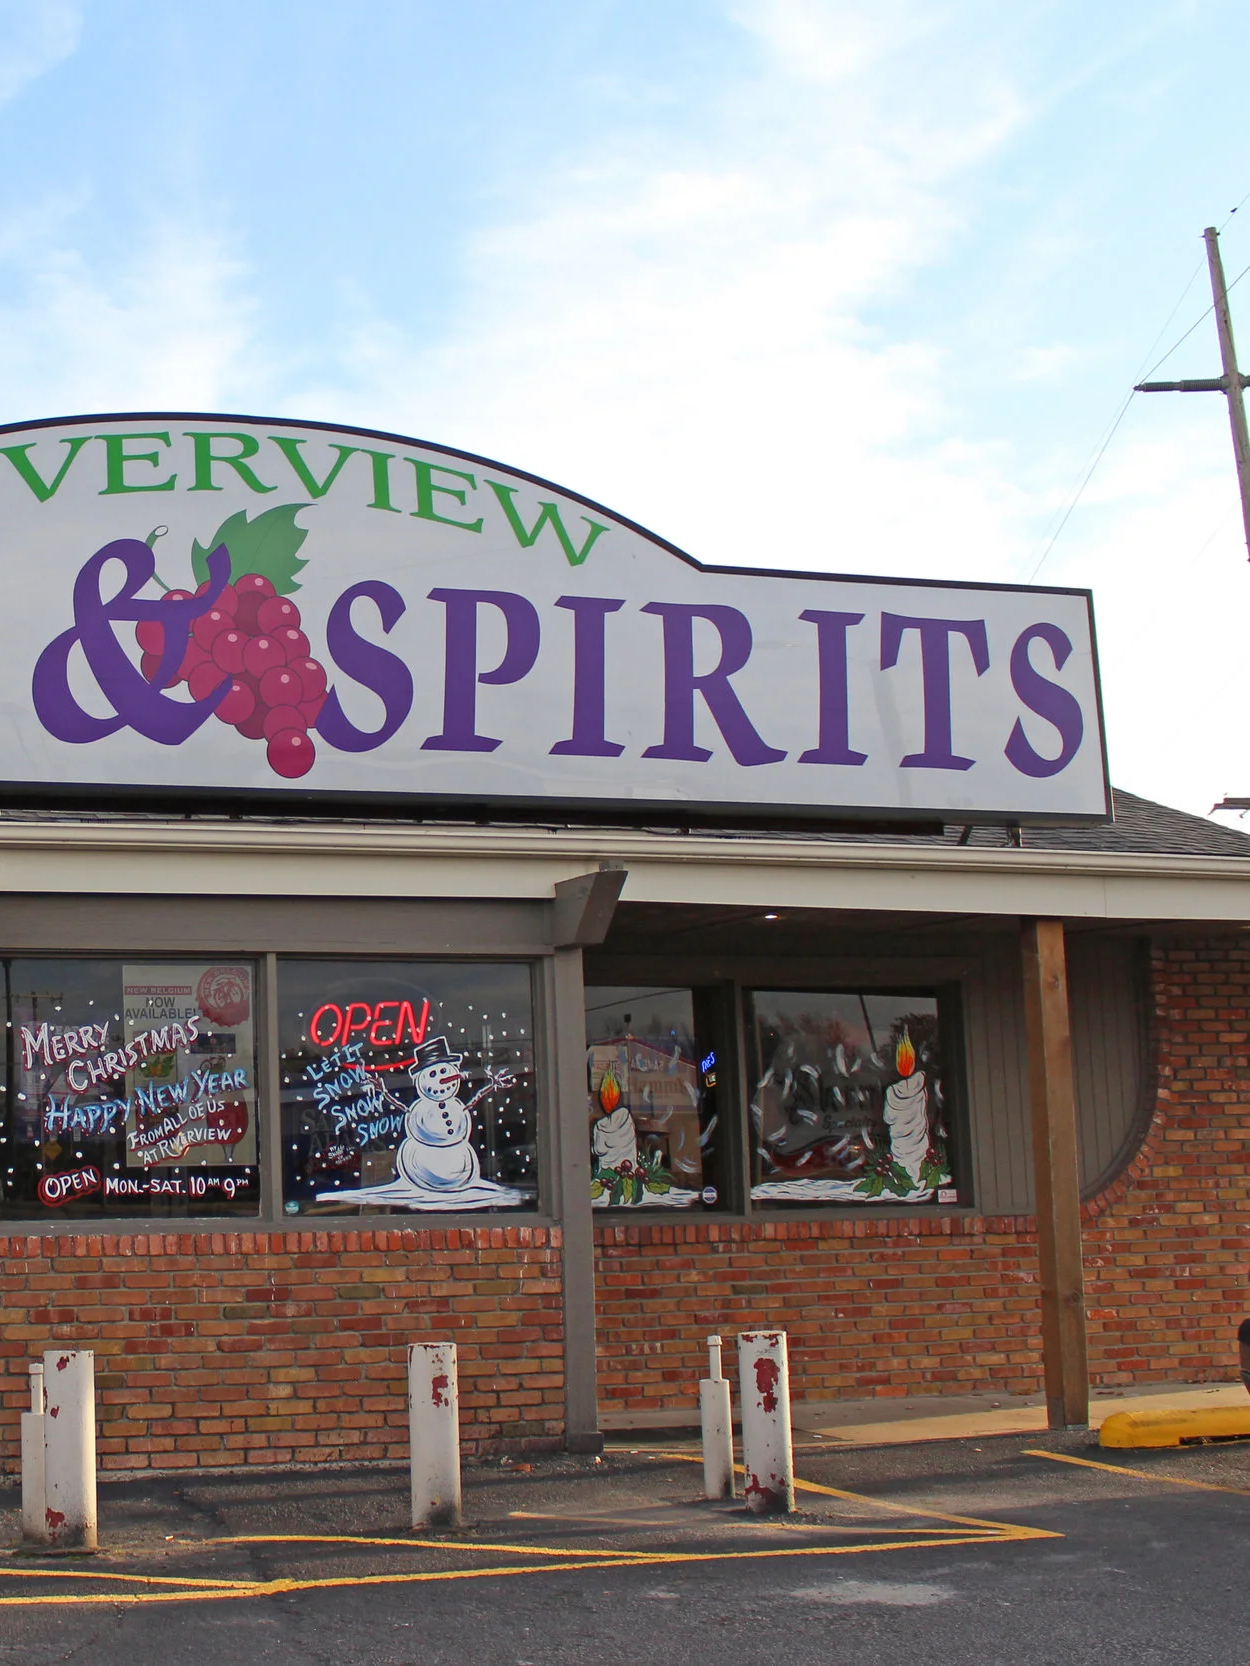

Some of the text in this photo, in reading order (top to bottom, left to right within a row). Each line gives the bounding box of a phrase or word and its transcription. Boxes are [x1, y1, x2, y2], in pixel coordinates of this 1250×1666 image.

[32, 538, 233, 746] &
[314, 579, 1084, 779] SPIRITS
[126, 986, 191, 995] NEW BELGIUM
[145, 996, 176, 1008] NOW
[125, 1007, 197, 1020] AVAILABLE!
[310, 1000, 430, 1046] OPEN
[20, 1021, 109, 1070] MERRY
[68, 1015, 200, 1092] CHRISTMAS
[306, 1042, 364, 1081] LET IT
[46, 1067, 250, 1132] HAPPY NEW YEAR
[313, 1064, 367, 1110] SNOW
[127, 1125, 164, 1149] FROM
[163, 1112, 188, 1135] ALL
[207, 1099, 226, 1114] US
[331, 1091, 385, 1136] SNOW
[357, 1114, 405, 1146] SNOW
[143, 1147, 159, 1166] AT
[44, 1168, 98, 1199] OPEN
